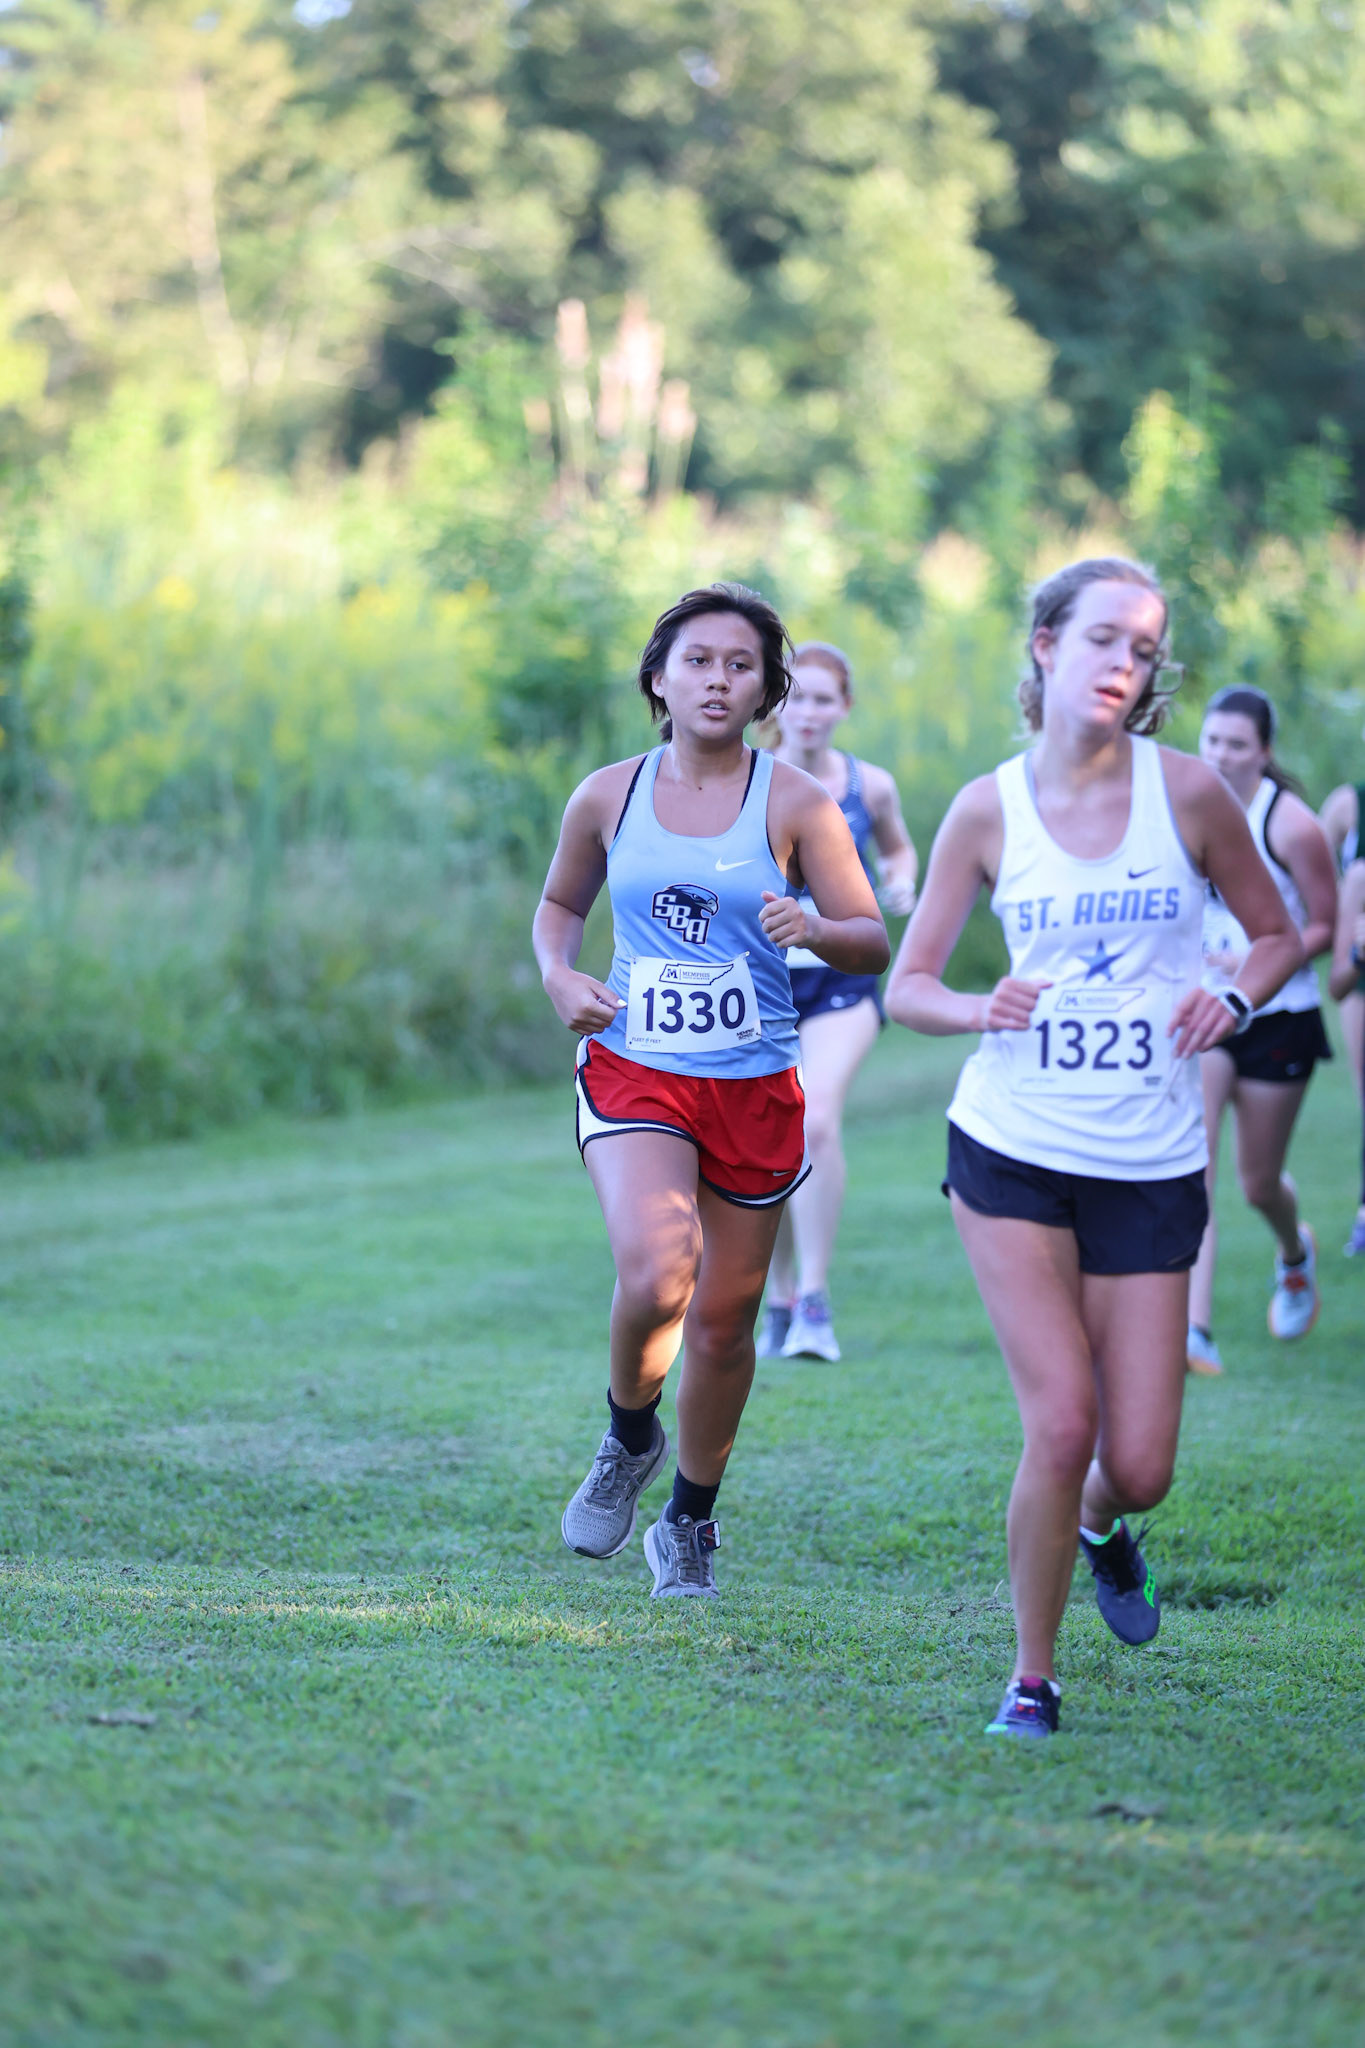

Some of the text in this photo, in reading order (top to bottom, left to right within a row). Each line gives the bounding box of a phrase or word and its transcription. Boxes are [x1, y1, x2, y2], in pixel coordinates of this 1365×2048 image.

[653, 893, 707, 944] SBA
[1018, 887, 1180, 933] ST. AGNES
[666, 968, 678, 979] M
[642, 987, 746, 1034] 1330
[1035, 1019, 1153, 1071] 1323
